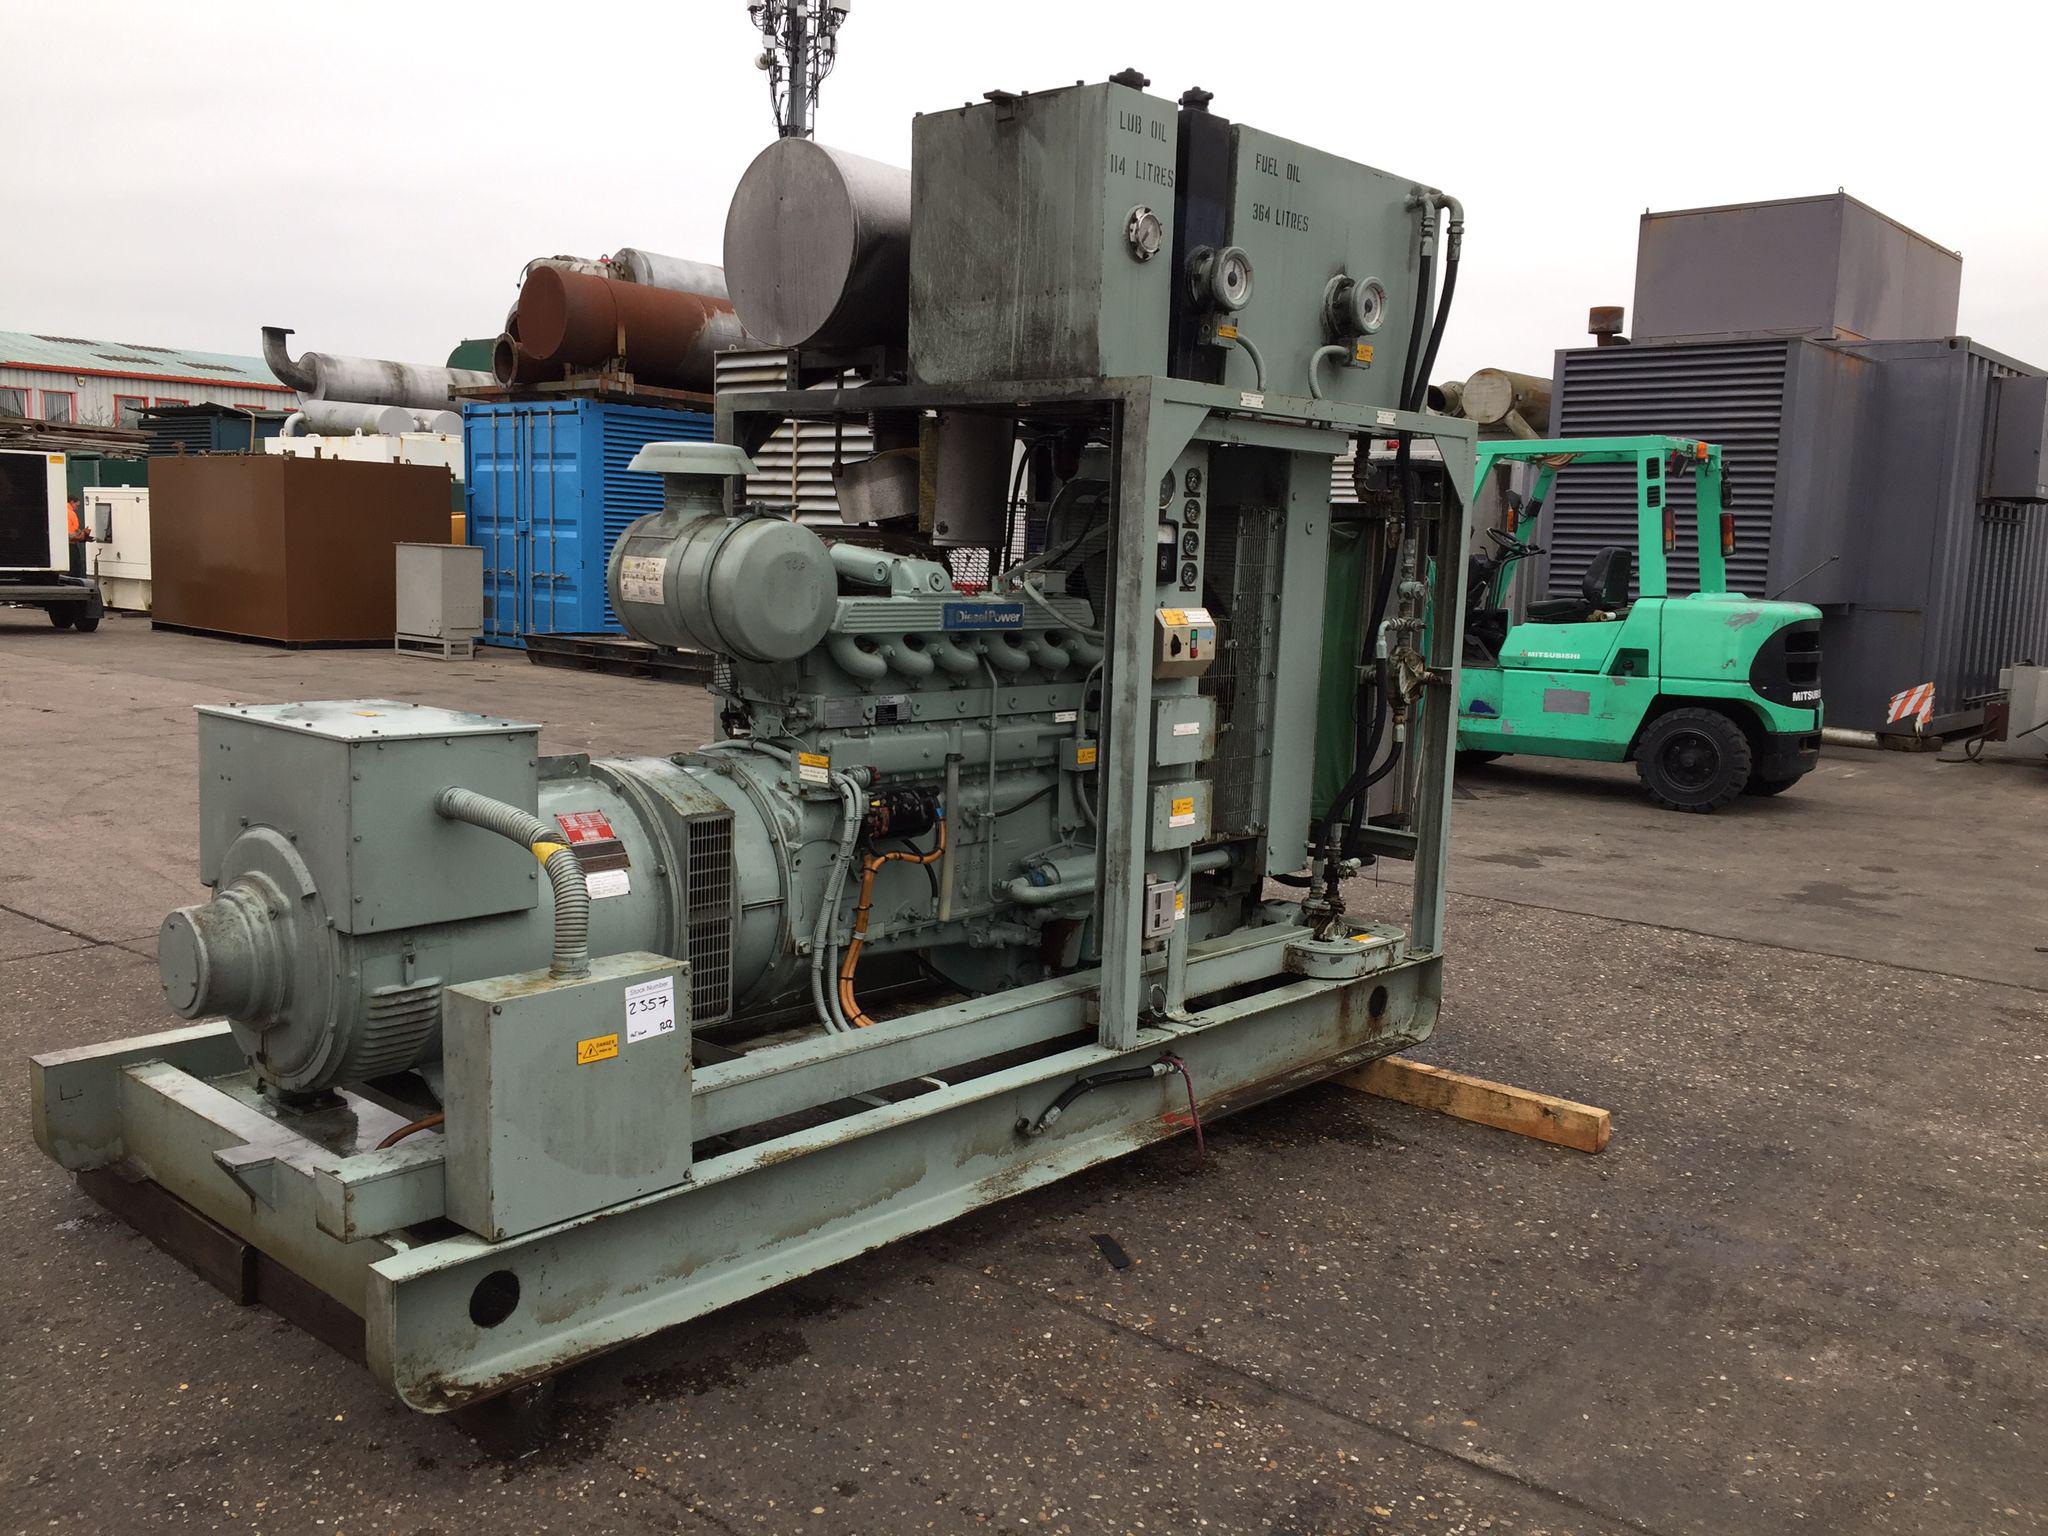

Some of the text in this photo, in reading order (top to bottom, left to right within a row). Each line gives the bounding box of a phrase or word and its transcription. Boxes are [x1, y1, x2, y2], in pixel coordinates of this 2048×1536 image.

[1119, 110, 1167, 143] LUB OIL
[1110, 153, 1175, 188] 114 LITRES
[1255, 153, 1301, 183] FUEL OIL
[1252, 202, 1310, 233] 364 LITRES
[1527, 651, 1581, 660] MITSUBISHI
[646, 980, 669, 992] Number
[628, 995, 669, 1016] 2357
